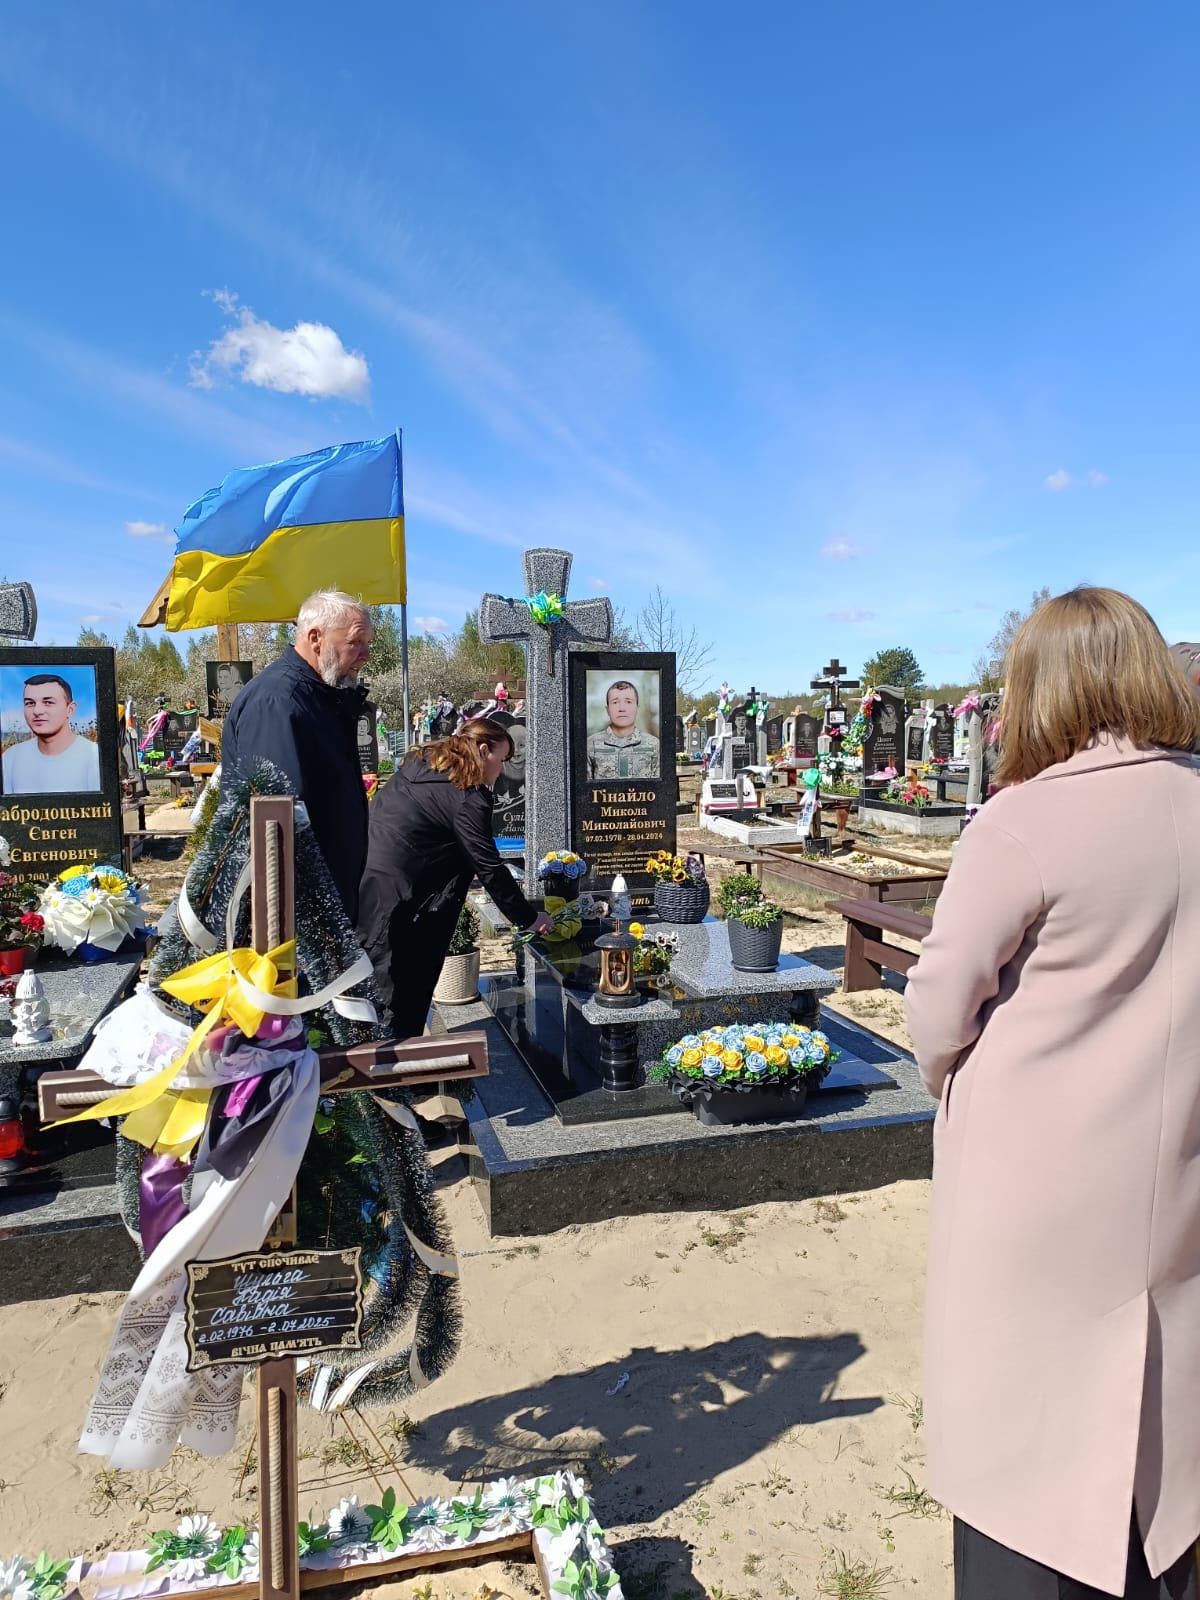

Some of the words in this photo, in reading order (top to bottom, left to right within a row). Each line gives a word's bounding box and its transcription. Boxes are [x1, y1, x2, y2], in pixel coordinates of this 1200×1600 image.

[591, 788, 656, 803] Гінайло
[0, 802, 112, 824] абродоцький
[600, 806, 648, 817] Микола
[581, 818, 666, 831] Миколайович
[28, 826, 78, 840] Євген
[10, 848, 98, 863] Євгенович
[231, 1260, 257, 1273] ТУТ
[258, 1255, 320, 1269] СПОЧИВАЄ
[231, 1343, 267, 1358] ВІЧНА
[269, 1336, 323, 1351] ПАМ'ЯТЬ
